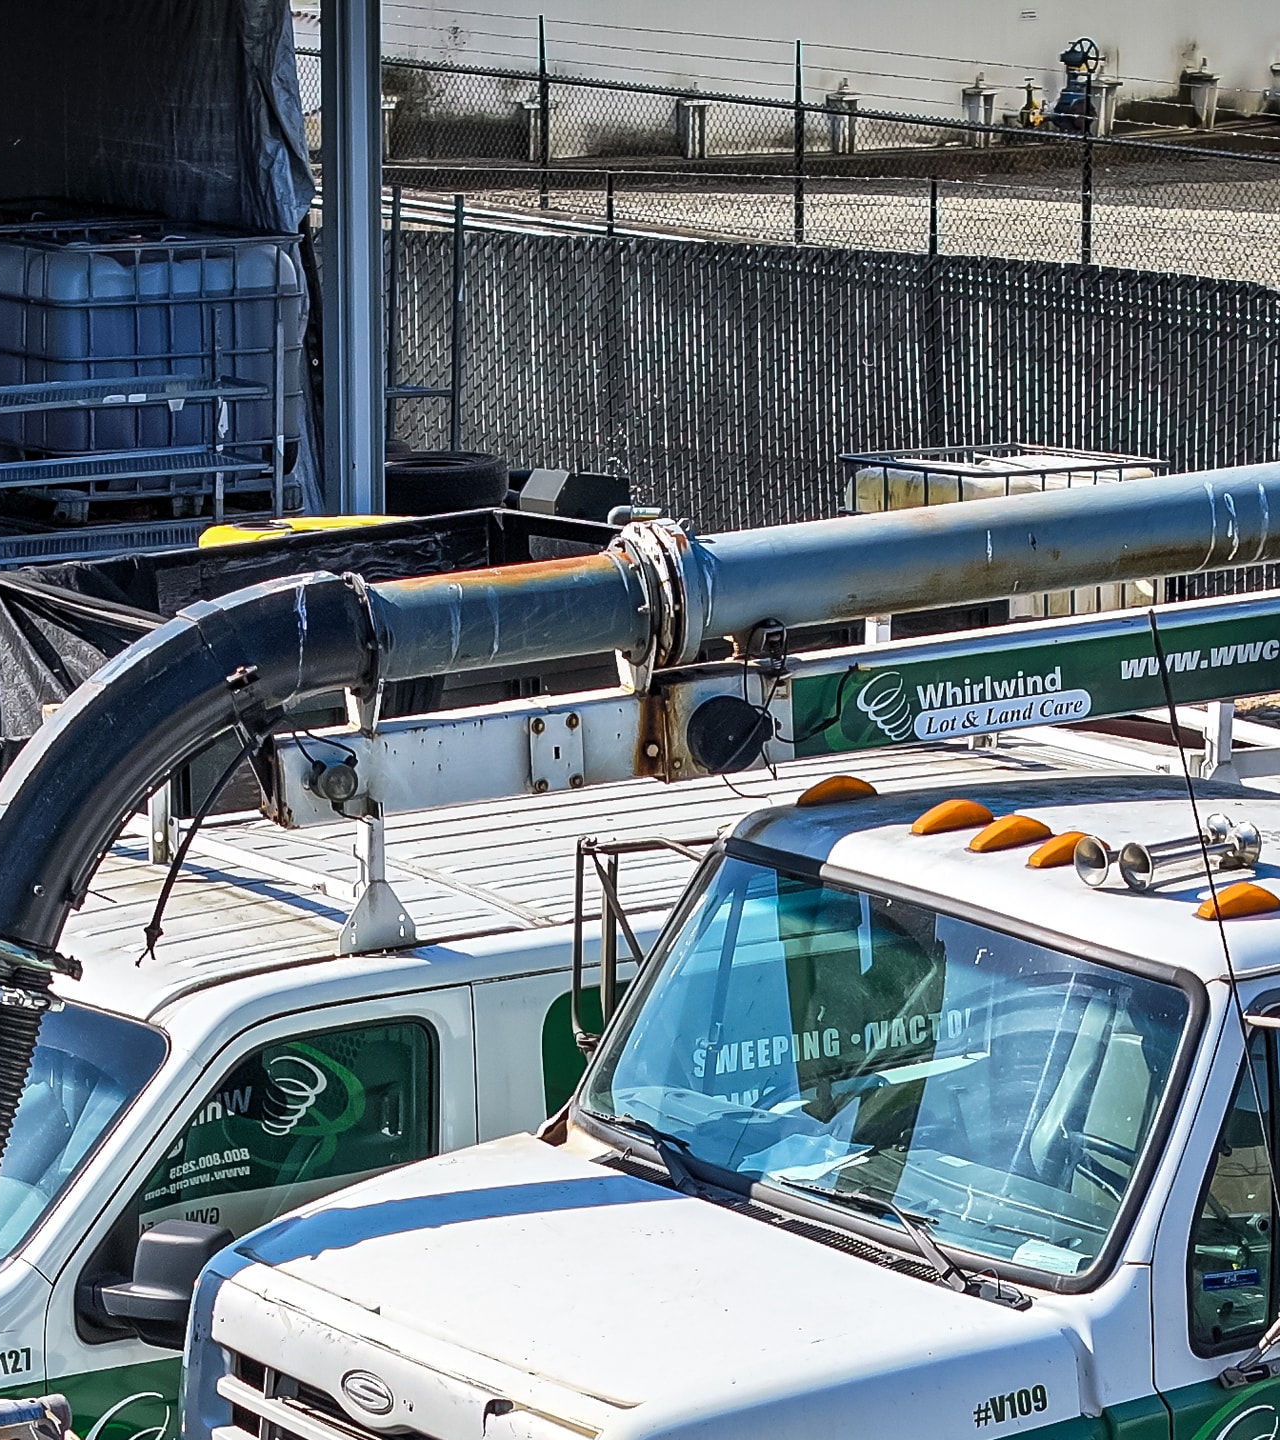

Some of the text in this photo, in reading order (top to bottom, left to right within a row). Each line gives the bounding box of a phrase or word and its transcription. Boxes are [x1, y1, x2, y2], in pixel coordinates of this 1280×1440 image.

[916, 666, 1063, 710] Whirlwind
[925, 698, 1084, 736] Lot & Land Care
[692, 1028, 840, 1079] SWEEPING
[973, 1384, 1048, 1428] #V109
